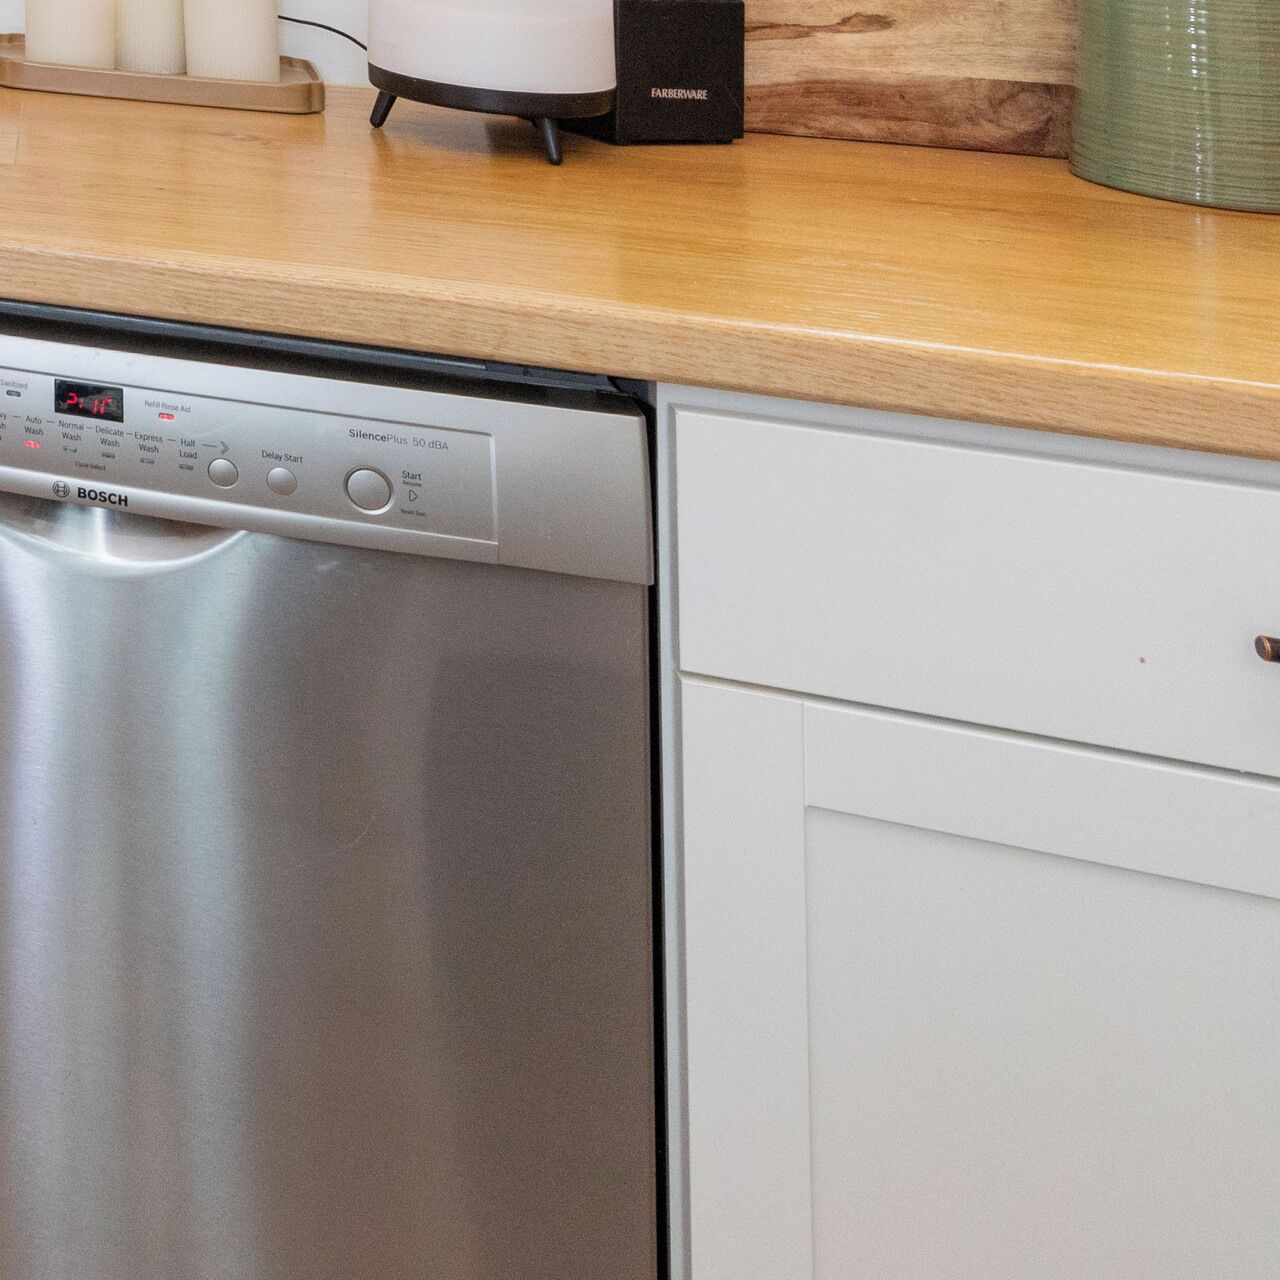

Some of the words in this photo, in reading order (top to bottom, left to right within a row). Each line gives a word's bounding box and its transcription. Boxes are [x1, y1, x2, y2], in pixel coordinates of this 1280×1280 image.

[651, 87, 709, 100] FARBERWARE
[0, 379, 28, 389] Sanitized
[26, 415, 42, 424] Auto
[24, 426, 44, 436] Wash
[58, 420, 85, 431] Normal
[95, 425, 124, 437] Delicate
[61, 431, 82, 441] Wash
[134, 431, 163, 444] Express
[348, 429, 408, 446] SilencePlus
[412, 437, 426, 449] 50
[428, 438, 449, 451] dBA
[100, 437, 120, 448] Wash
[180, 438, 196, 448] Half
[138, 443, 159, 454] Wash
[179, 449, 198, 460] Load
[261, 450, 282, 462] Delay
[284, 453, 304, 464] Start
[402, 470, 422, 481] Start
[77, 486, 129, 507] BOSCH
